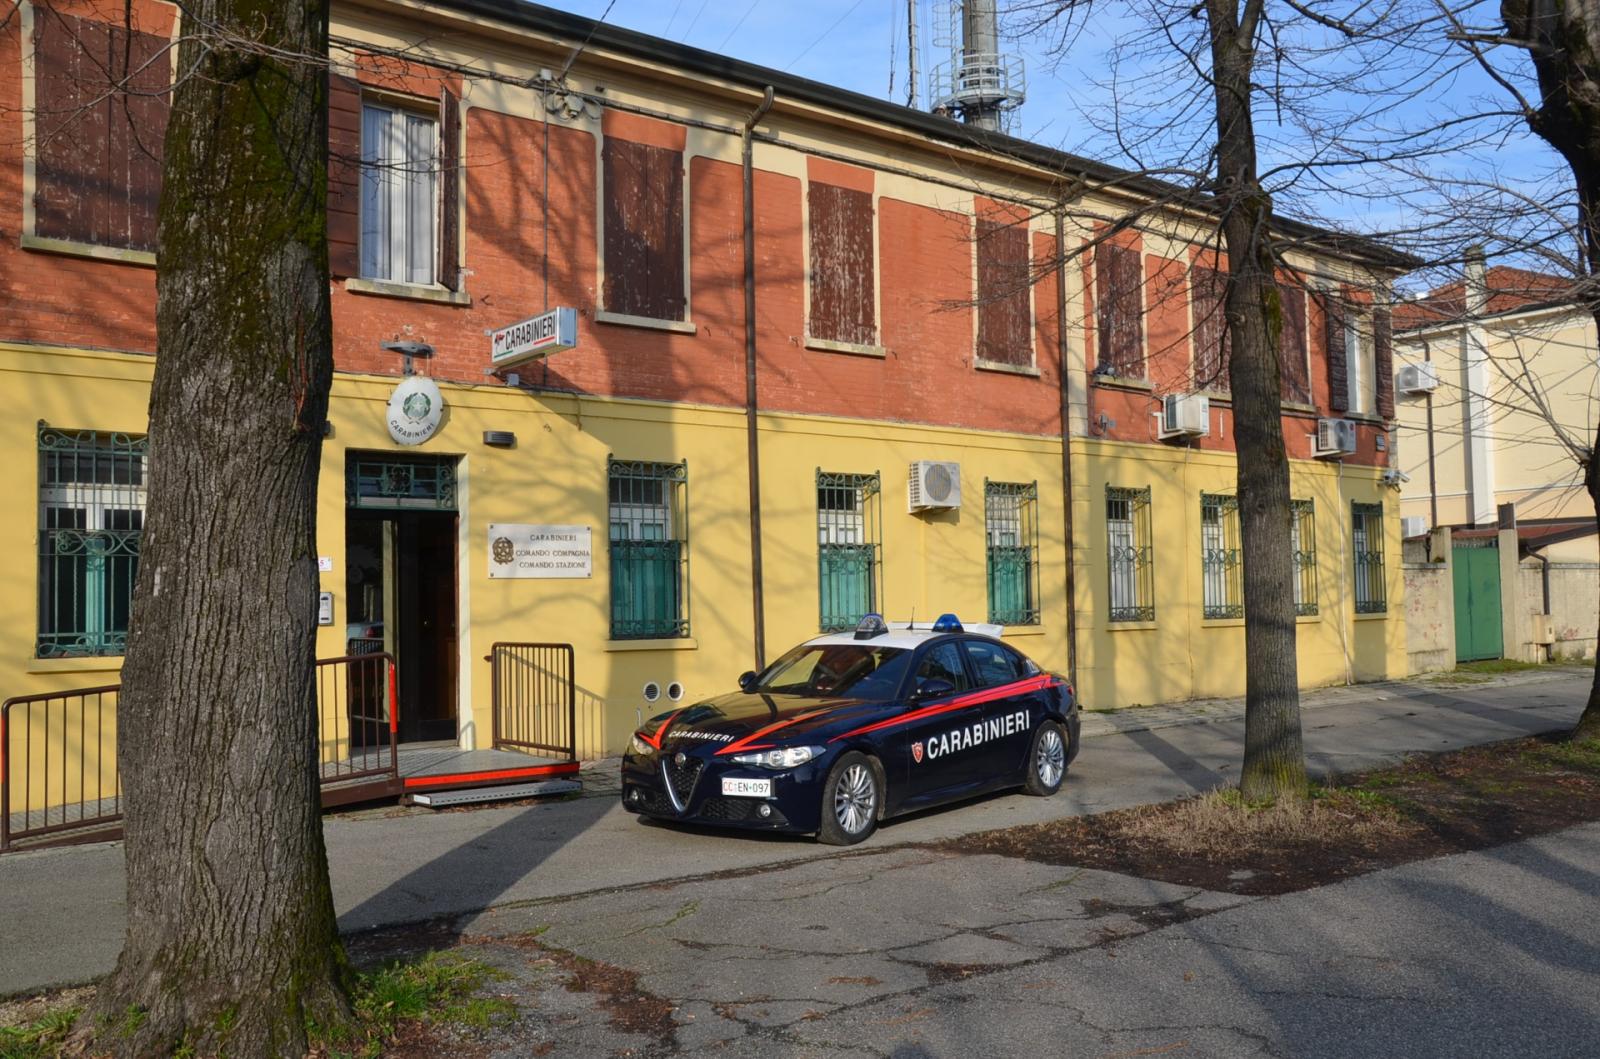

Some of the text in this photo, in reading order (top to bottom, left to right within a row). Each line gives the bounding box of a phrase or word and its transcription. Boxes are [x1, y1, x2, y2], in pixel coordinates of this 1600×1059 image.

[505, 315, 556, 350] CARABINIERI
[390, 420, 434, 438] CARABINIERI
[530, 534, 577, 542] CARABINIERI
[515, 549, 590, 557] COMANDO COMPAGNIA
[519, 561, 586, 569] COMANDO STAZIONE
[668, 731, 735, 742] CARABINIERI
[927, 709, 1030, 759] CARABINIERI
